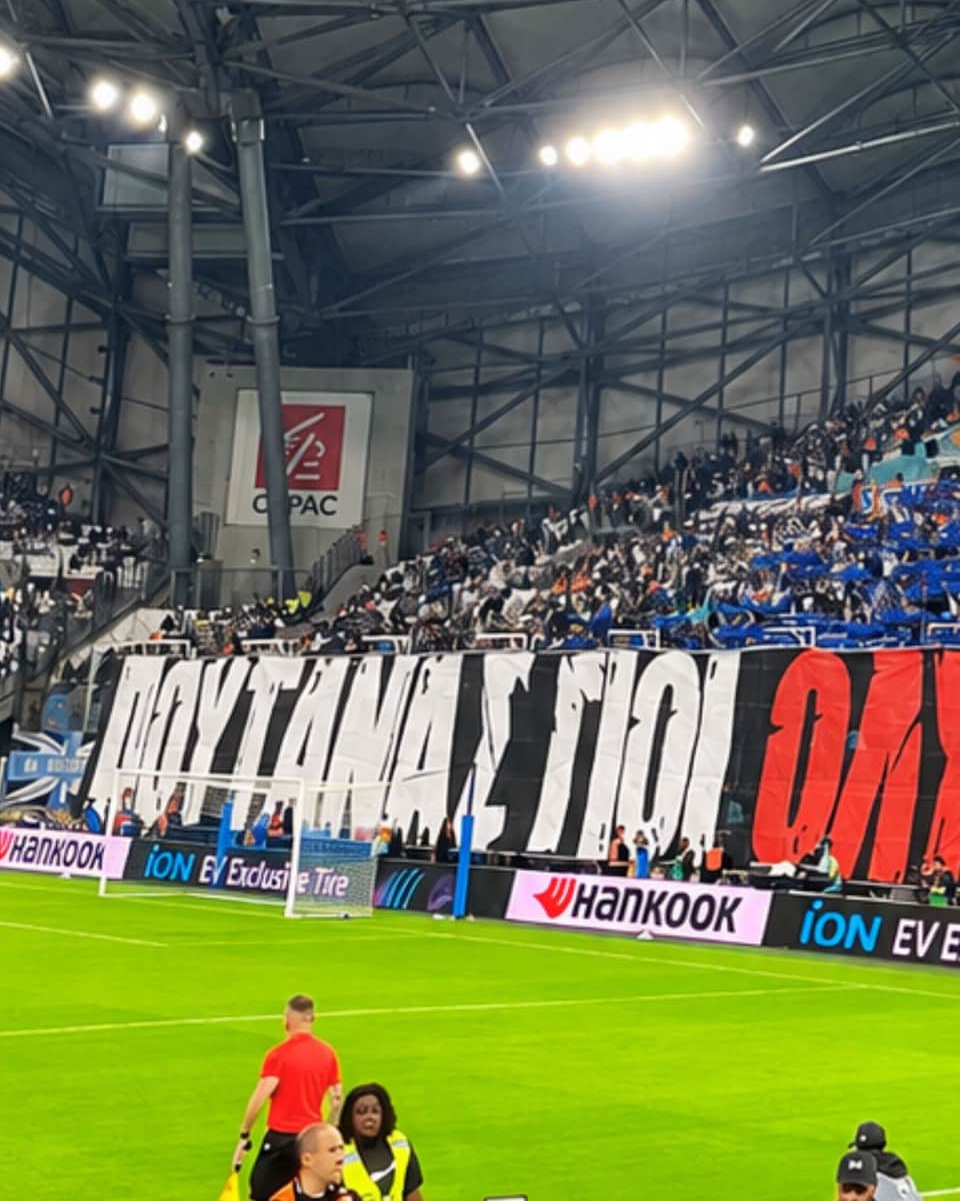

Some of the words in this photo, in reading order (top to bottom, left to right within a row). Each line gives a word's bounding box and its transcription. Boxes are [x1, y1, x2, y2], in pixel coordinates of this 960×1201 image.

[252, 494, 338, 516] CPAC
[226, 857, 309, 893] Exclusie
[313, 866, 349, 897] Tire
[892, 918, 940, 957] EV
